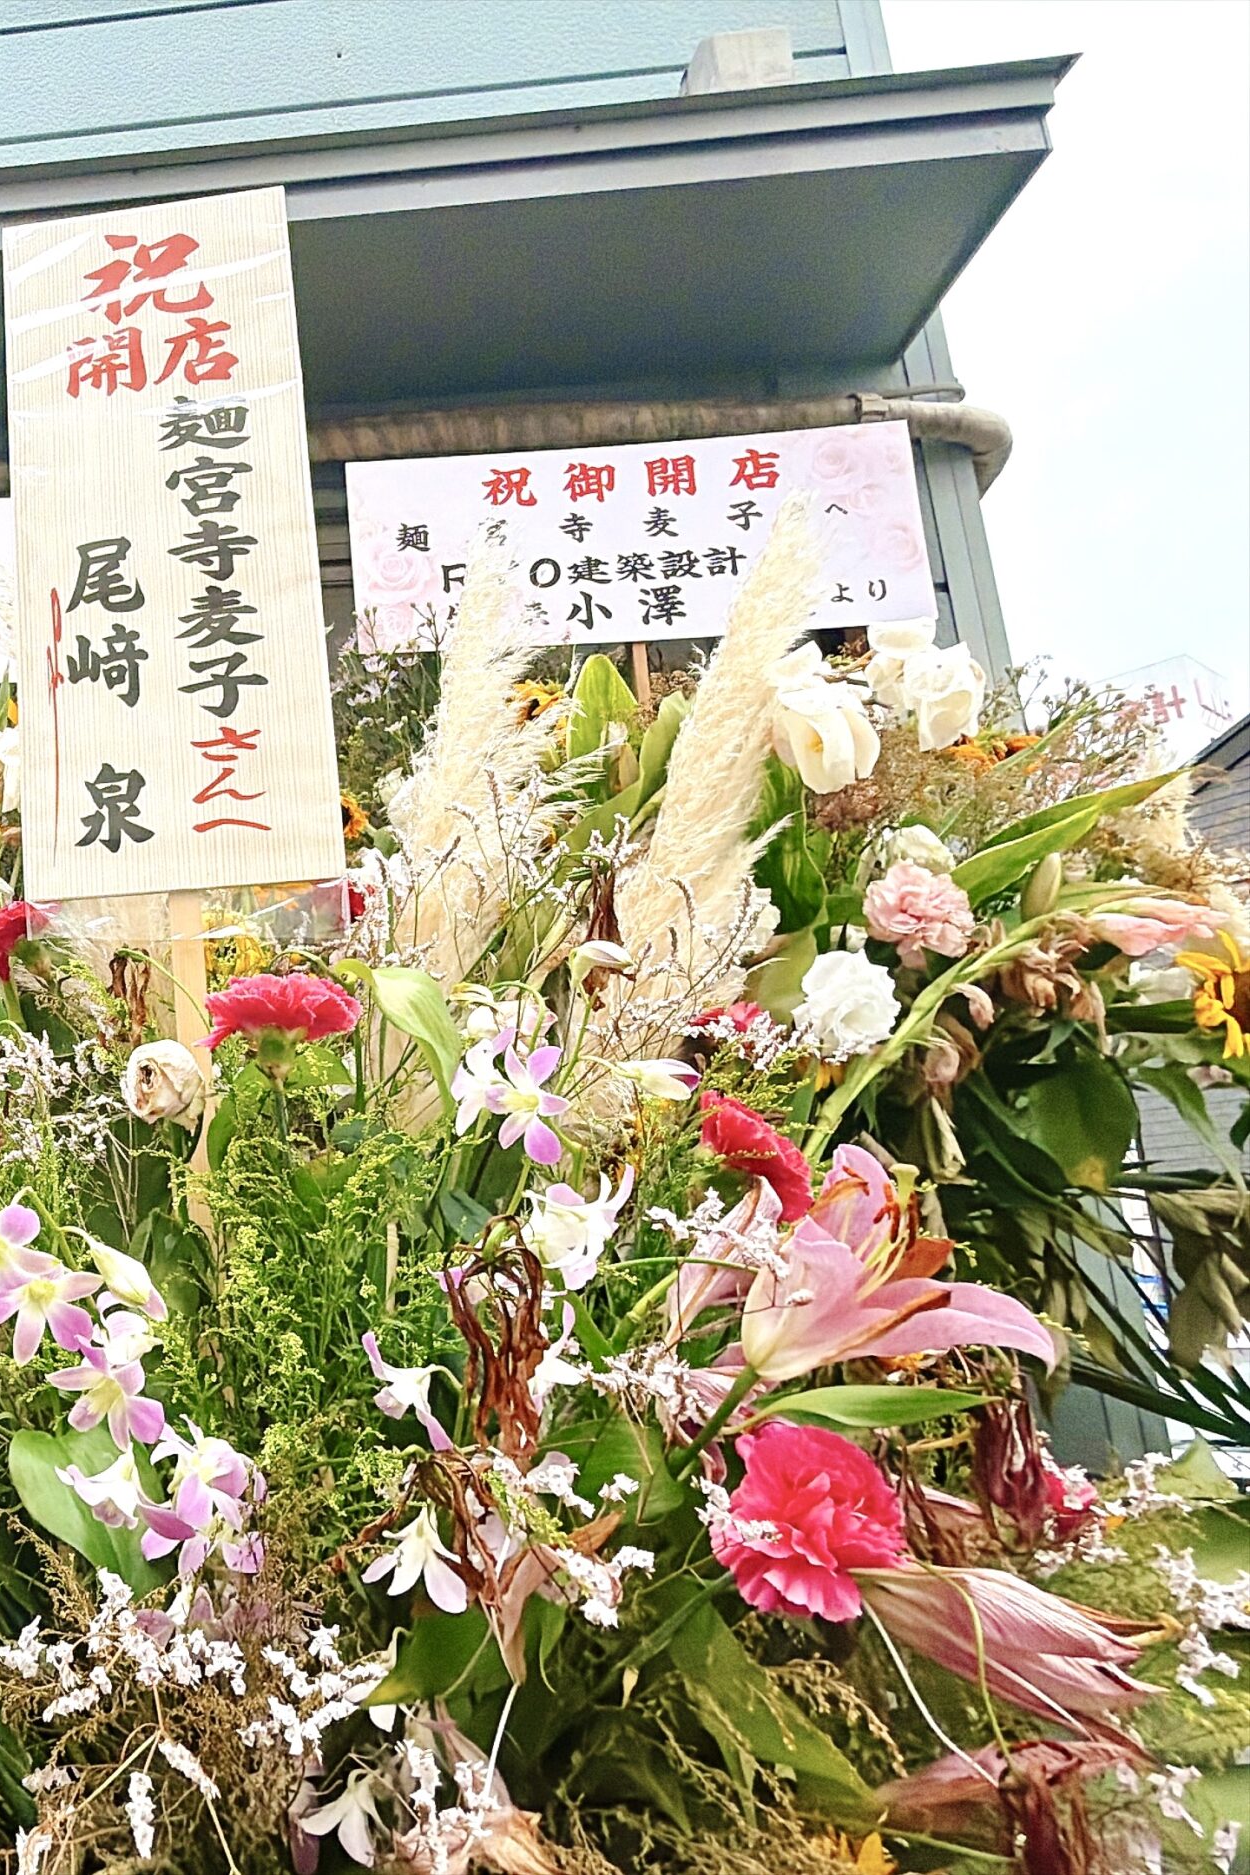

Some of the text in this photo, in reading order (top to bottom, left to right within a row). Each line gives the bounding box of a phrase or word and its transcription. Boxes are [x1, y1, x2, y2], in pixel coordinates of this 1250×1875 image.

[81, 233, 214, 324] 祝
[67, 318, 240, 398] 開店
[482, 449, 781, 507] 祝御開店
[75, 763, 155, 853] 泉
